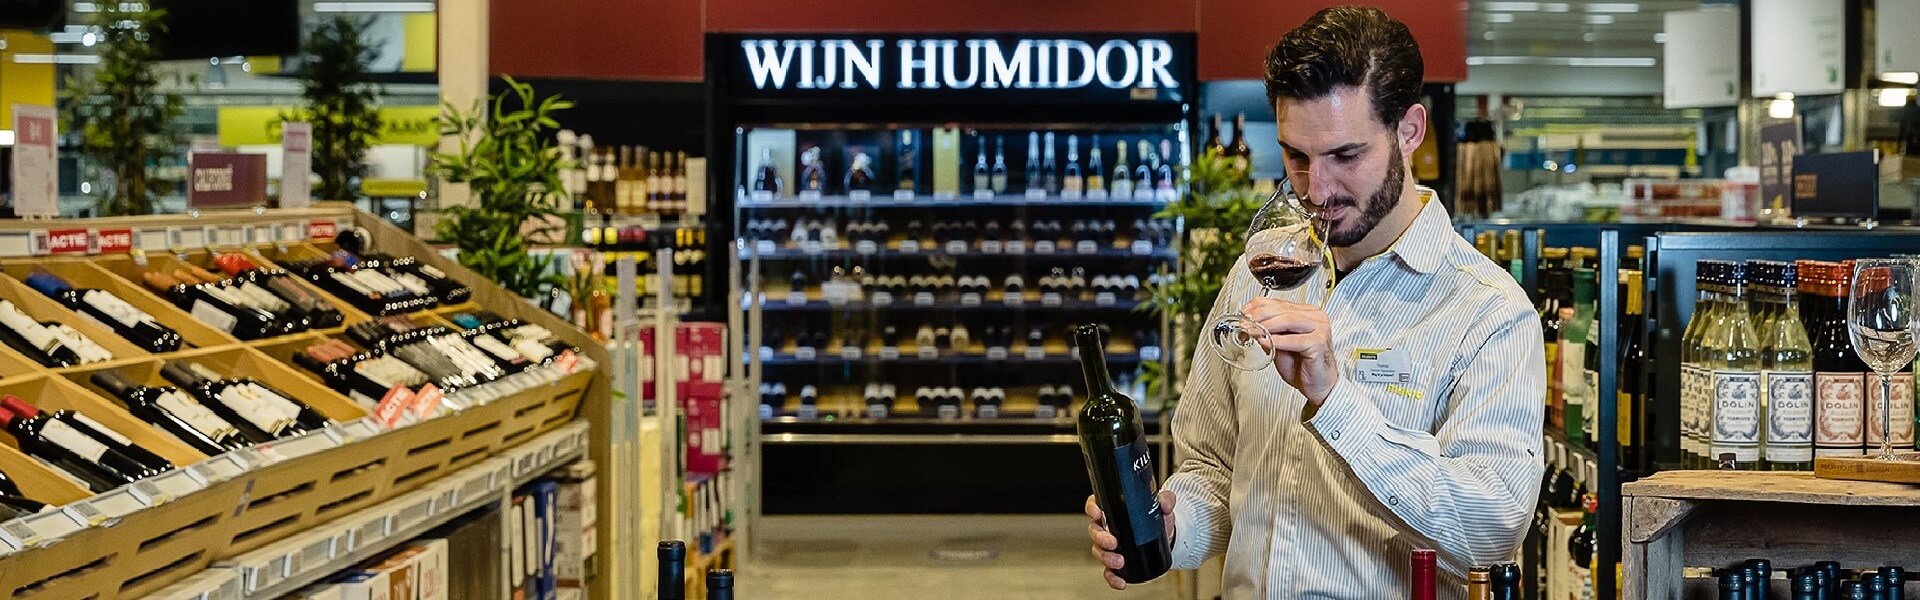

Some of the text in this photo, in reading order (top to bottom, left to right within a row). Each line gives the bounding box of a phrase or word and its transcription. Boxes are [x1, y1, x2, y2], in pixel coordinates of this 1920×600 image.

[741, 39, 1179, 89] WIJN HUMIDOR
[50, 233, 87, 248] ACTIE
[98, 233, 130, 248] ACTIE
[1387, 383, 1424, 400] makro
[1722, 400, 1754, 408] DOLIN
